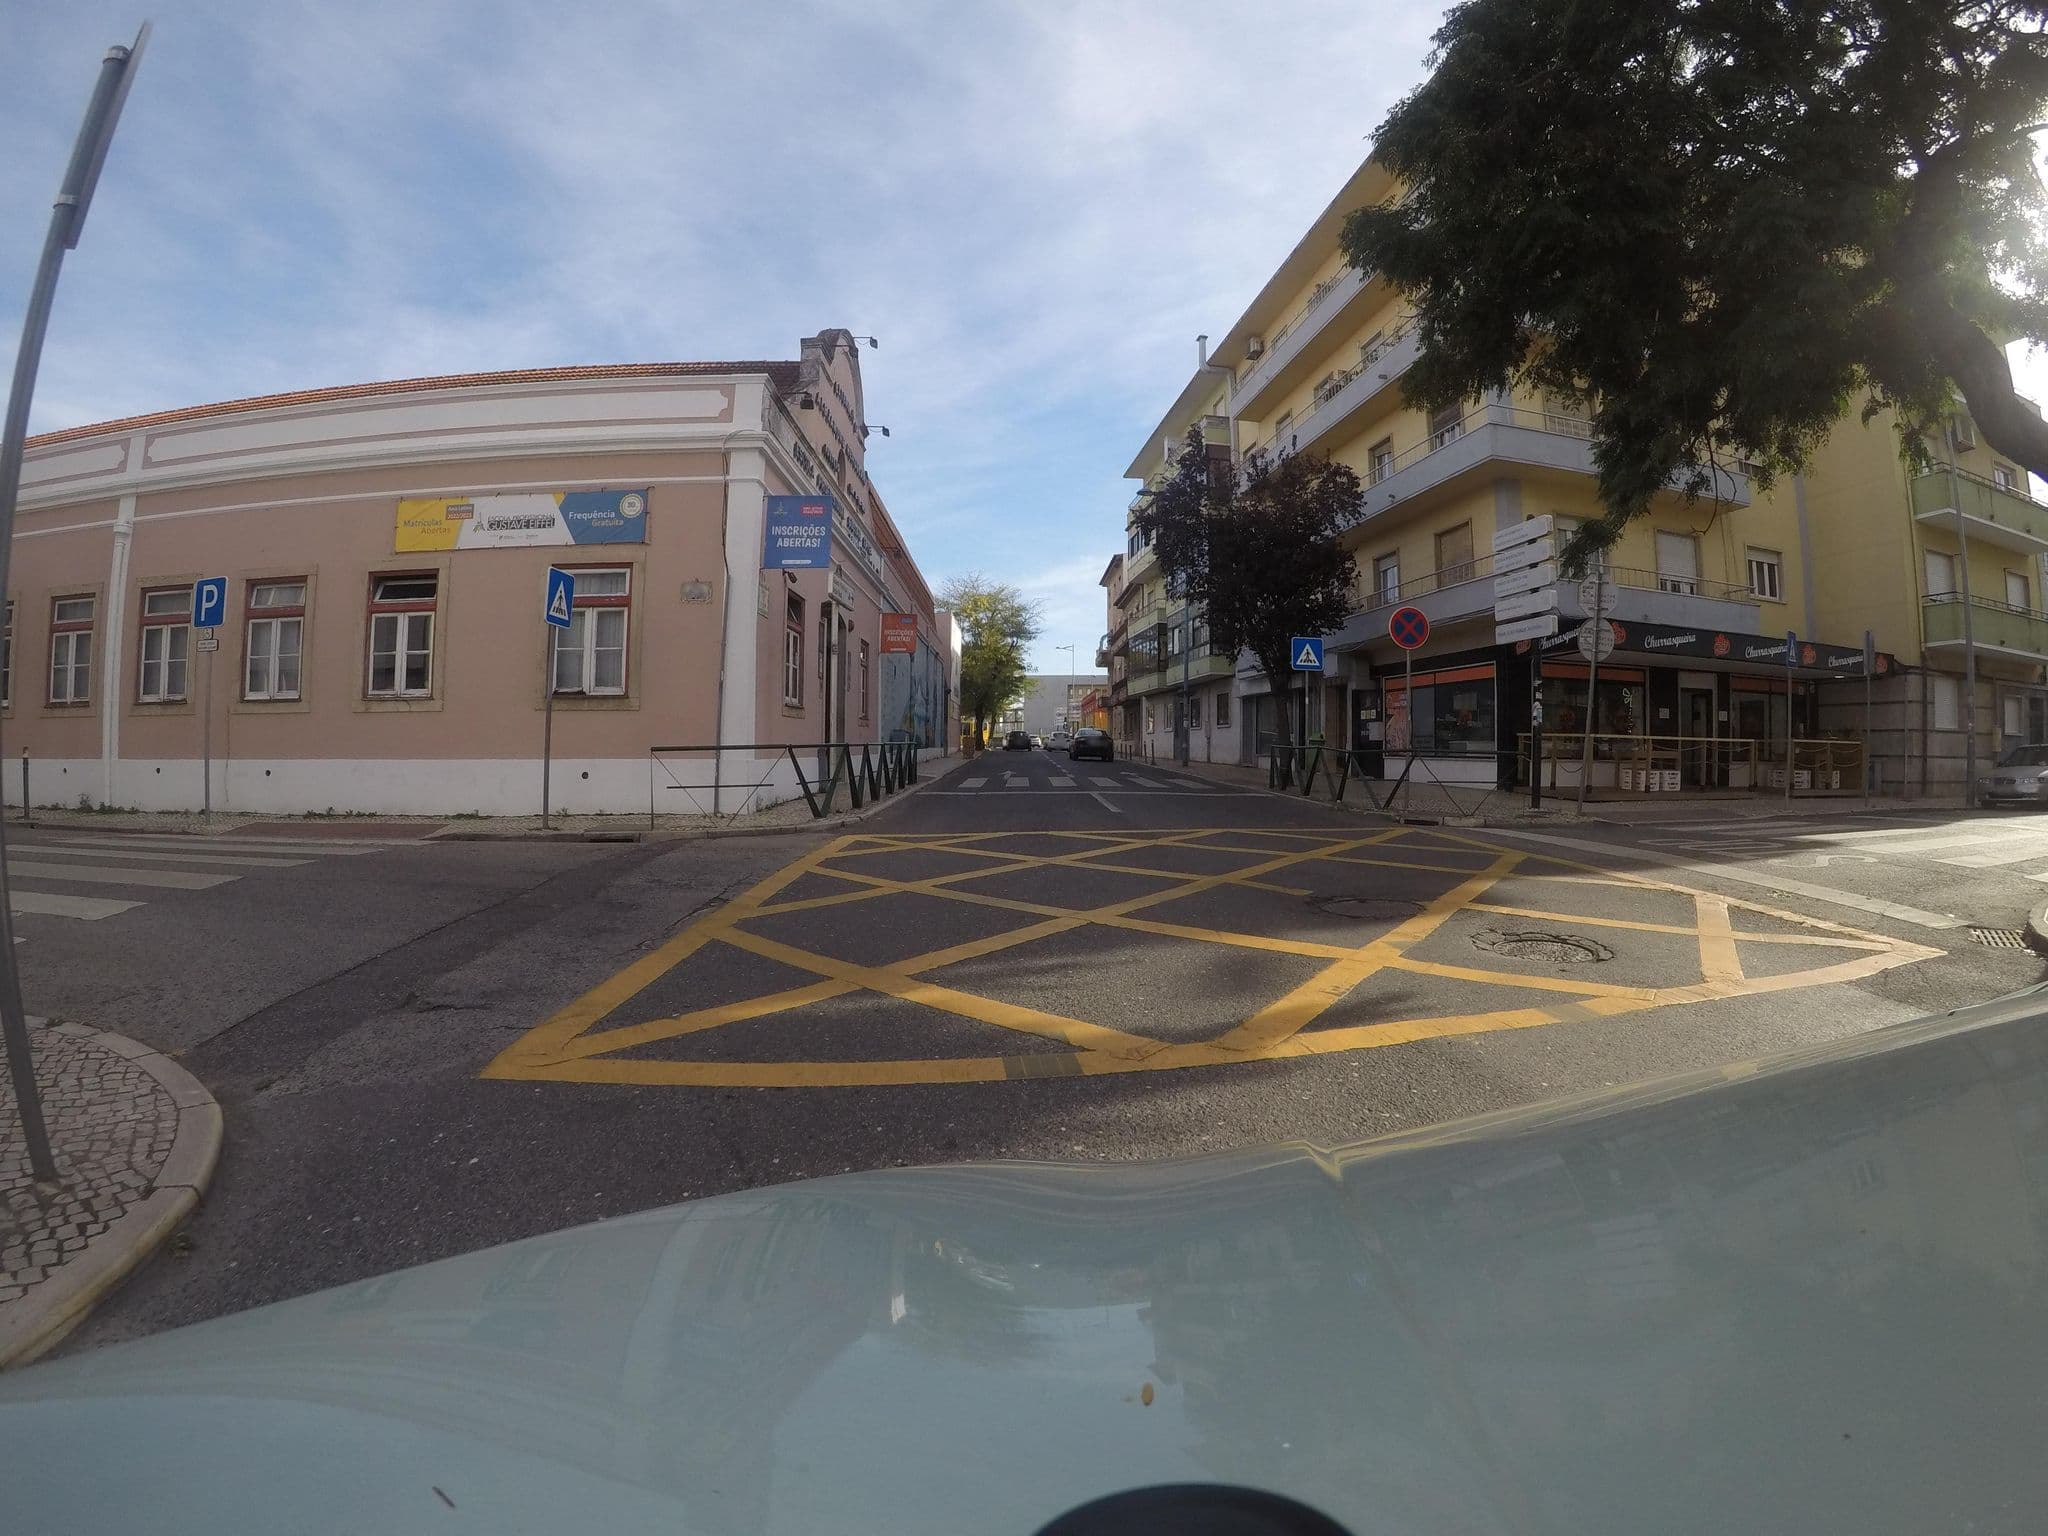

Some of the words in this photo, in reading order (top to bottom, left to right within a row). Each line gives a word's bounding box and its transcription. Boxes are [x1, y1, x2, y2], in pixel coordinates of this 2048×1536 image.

[568, 510, 616, 520] Frequência
[487, 519, 528, 531] GUSTAVE
[592, 518, 624, 527] Gratuita
[771, 523, 826, 538] INSCRIÇÕES
[776, 537, 821, 548] ABERTAS!
[201, 584, 219, 622] P
